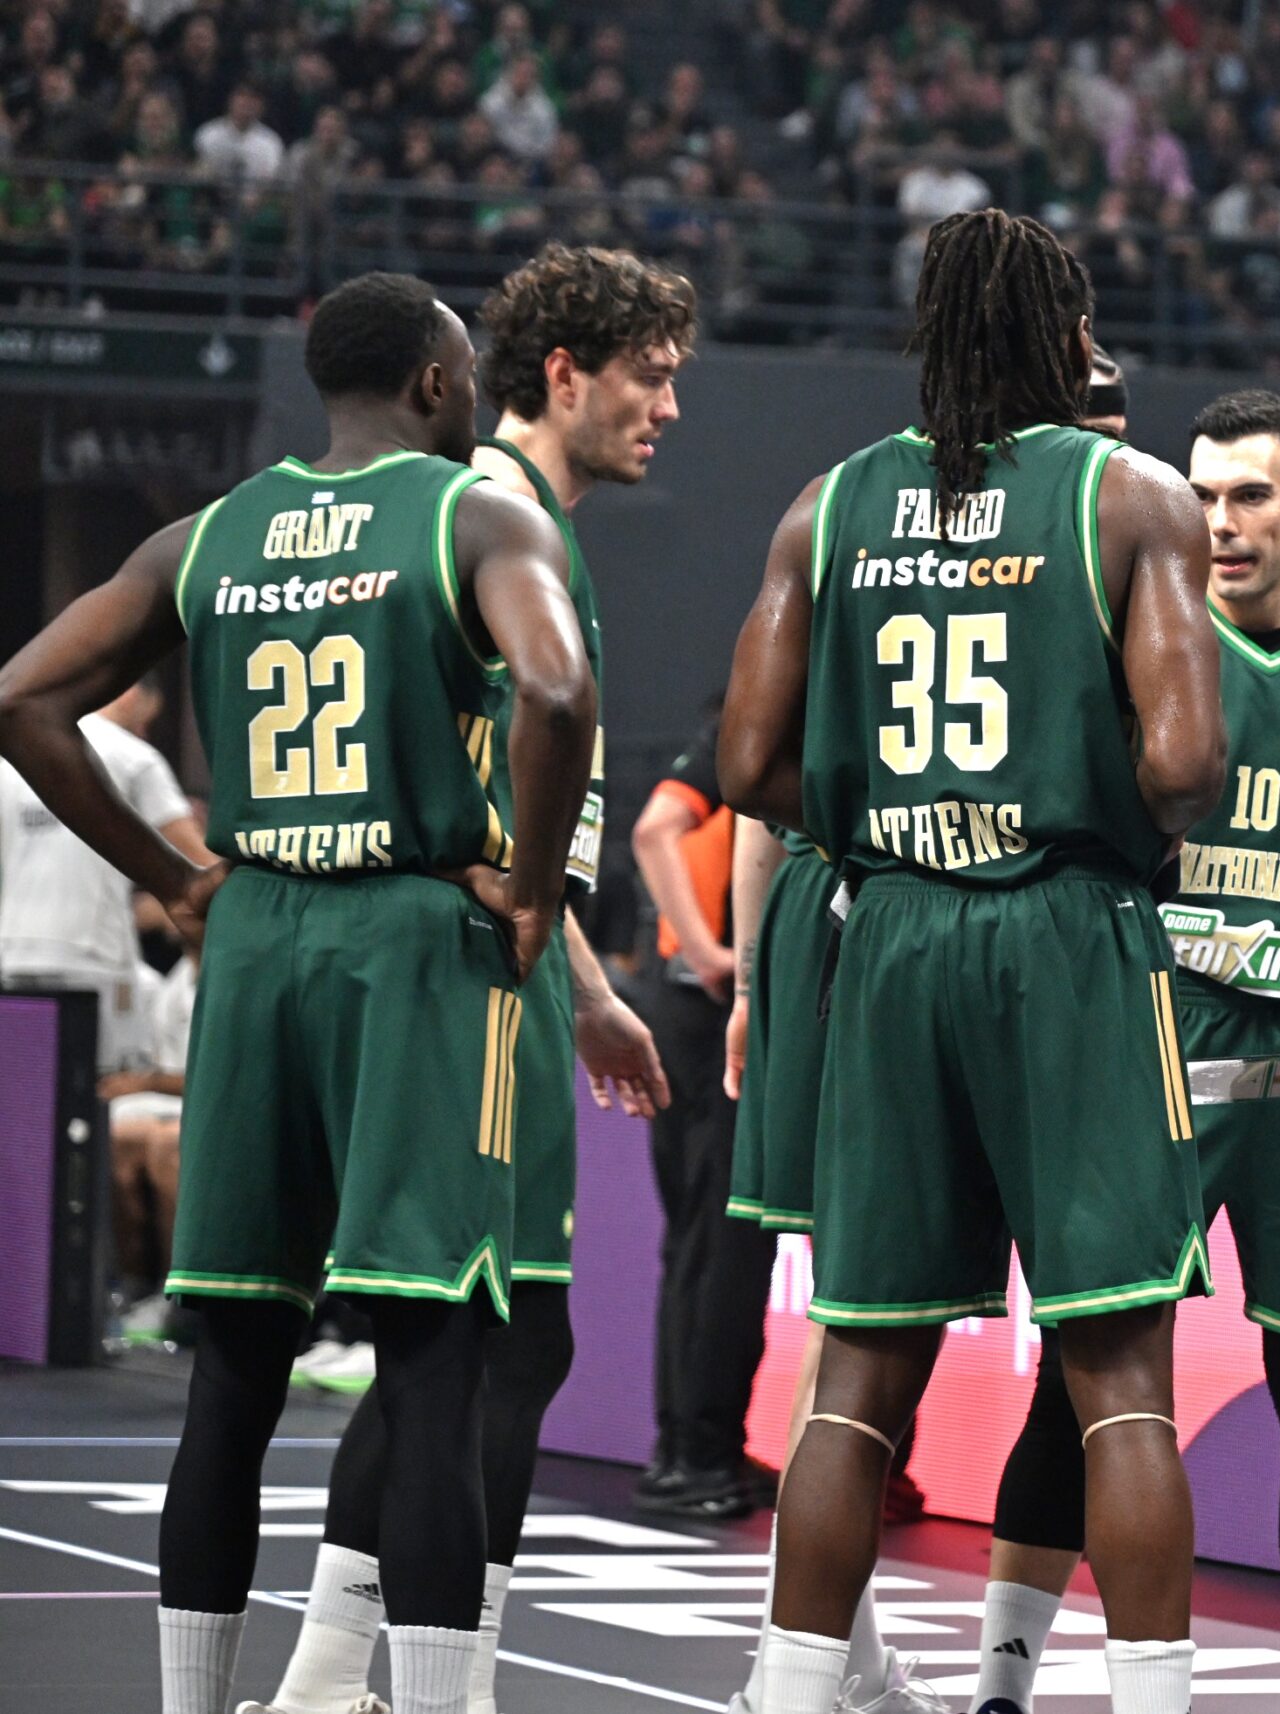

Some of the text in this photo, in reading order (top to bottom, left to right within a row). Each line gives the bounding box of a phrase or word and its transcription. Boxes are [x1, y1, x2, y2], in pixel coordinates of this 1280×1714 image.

[263, 503, 374, 560] GRANT
[215, 570, 399, 615] instacar
[852, 548, 1046, 589] instacar
[247, 634, 368, 799] 22
[876, 612, 1009, 775] 35
